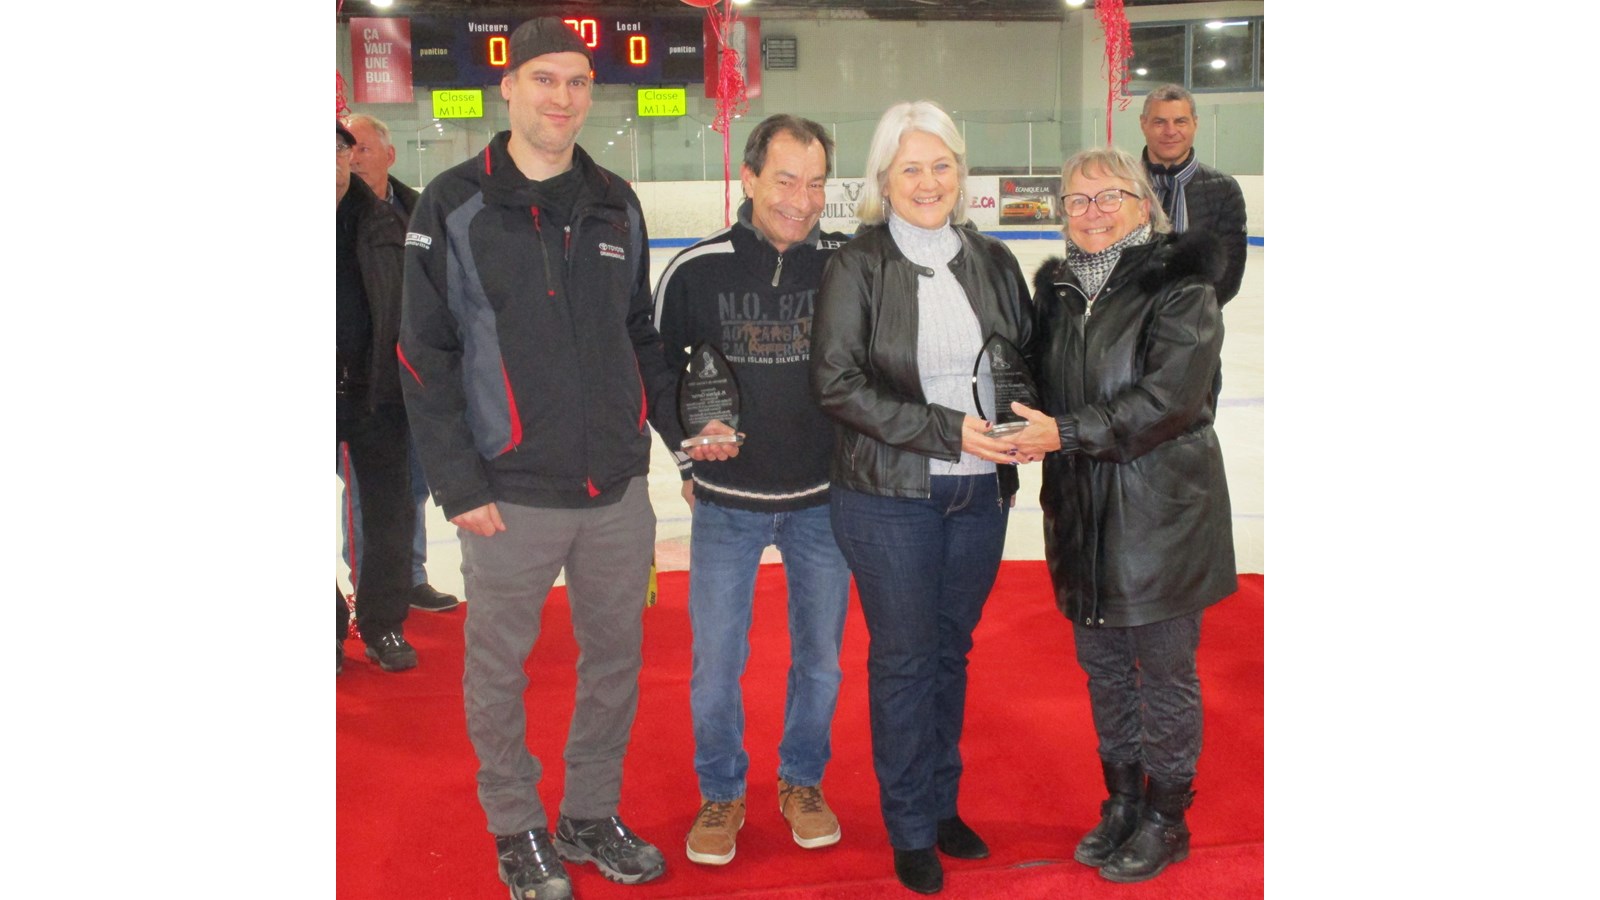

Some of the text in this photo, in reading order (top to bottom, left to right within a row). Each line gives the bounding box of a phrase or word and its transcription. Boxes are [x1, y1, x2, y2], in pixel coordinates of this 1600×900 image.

[468, 22, 509, 33] Visiteurs
[616, 21, 641, 31] Local
[363, 28, 380, 43] ÇA
[364, 42, 393, 55] VAUT
[419, 47, 448, 57] punition
[489, 36, 507, 66] 0
[629, 36, 647, 64] 0
[668, 46, 697, 54] punition
[365, 57, 389, 69] UNE
[366, 71, 393, 84] BUD.
[439, 91, 475, 102] Classe
[644, 90, 678, 101] Classe
[439, 106, 476, 117] M11-A
[643, 105, 680, 115] M11-A
[747, 356, 773, 365] ISLAND
[775, 354, 800, 364] SILVER
